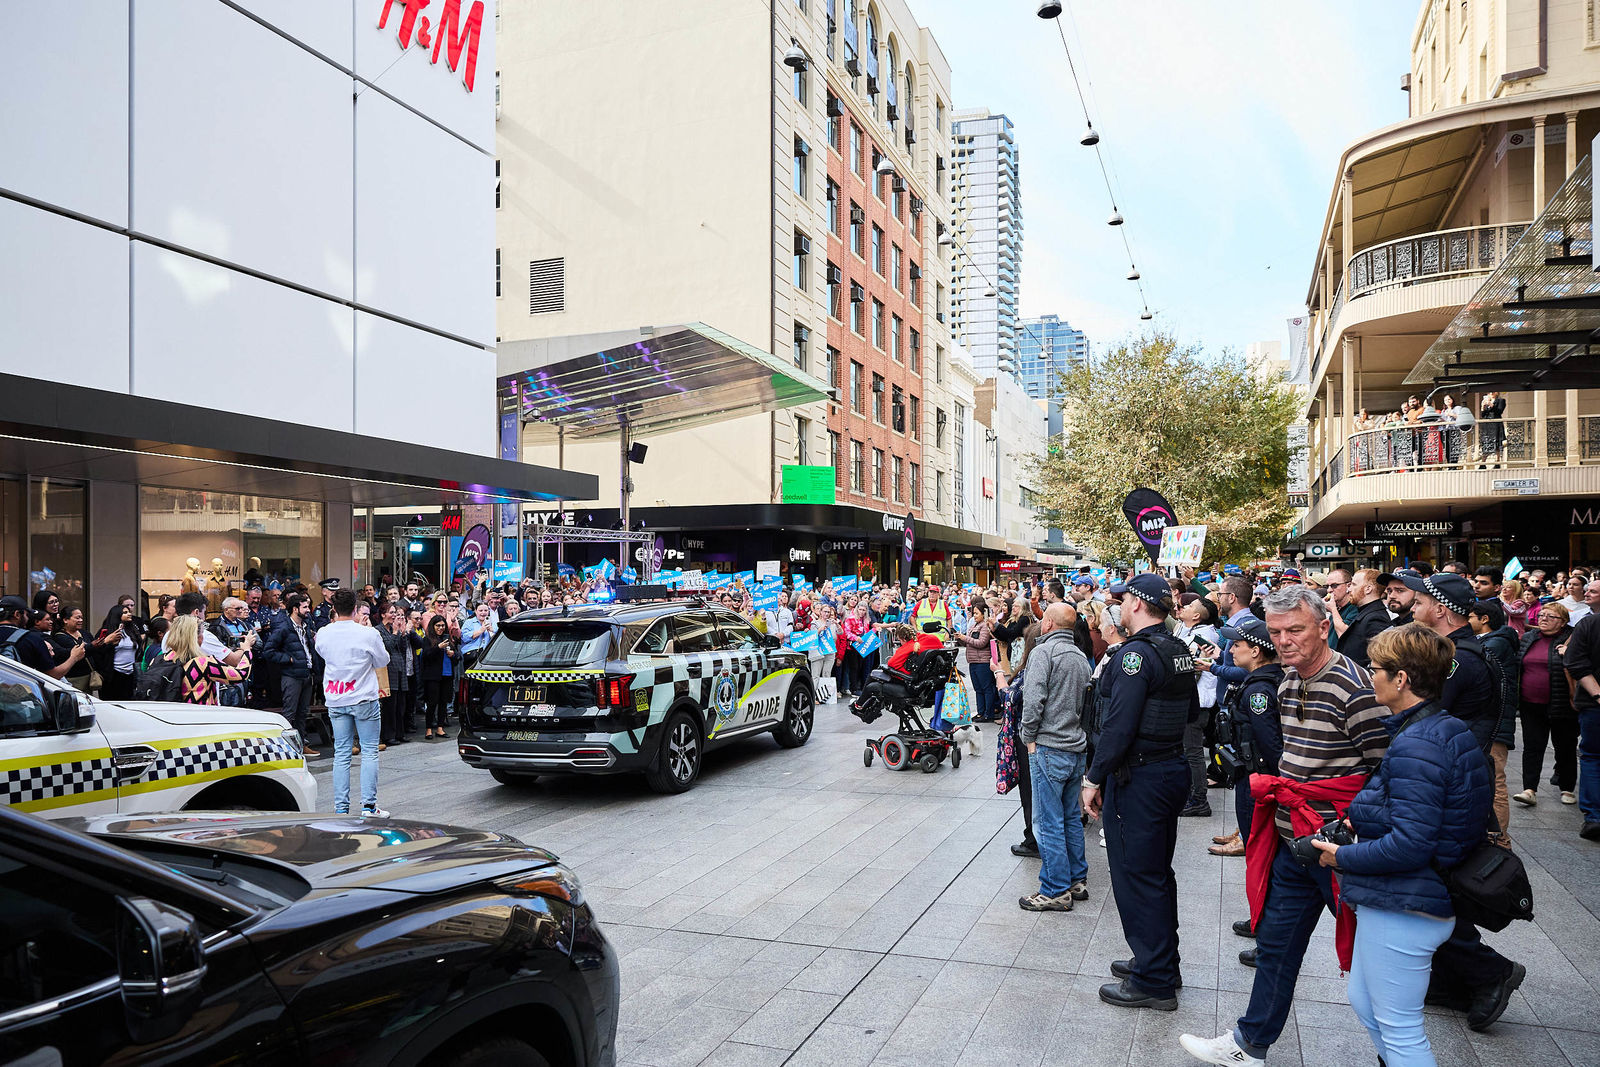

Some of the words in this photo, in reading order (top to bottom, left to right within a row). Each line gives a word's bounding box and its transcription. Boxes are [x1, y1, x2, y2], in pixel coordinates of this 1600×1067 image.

[379, 0, 484, 92] H&M
[442, 515, 460, 530] H&M
[527, 512, 575, 526] HYE
[888, 517, 905, 532] HYPE
[1141, 516, 1167, 532] MIX
[688, 540, 705, 548] HYPE
[833, 541, 865, 550] HYPE
[1311, 545, 1367, 556] OPTUS
[795, 550, 811, 561] HYPE
[792, 641, 800, 649] GO
[799, 633, 818, 646] SAMMY
[1174, 657, 1194, 672] POLICE
[325, 679, 357, 695] MIX
[514, 690, 520, 701] Y
[524, 690, 542, 701] DUI
[744, 696, 781, 723] POLICE
[506, 731, 540, 742] POLICE
